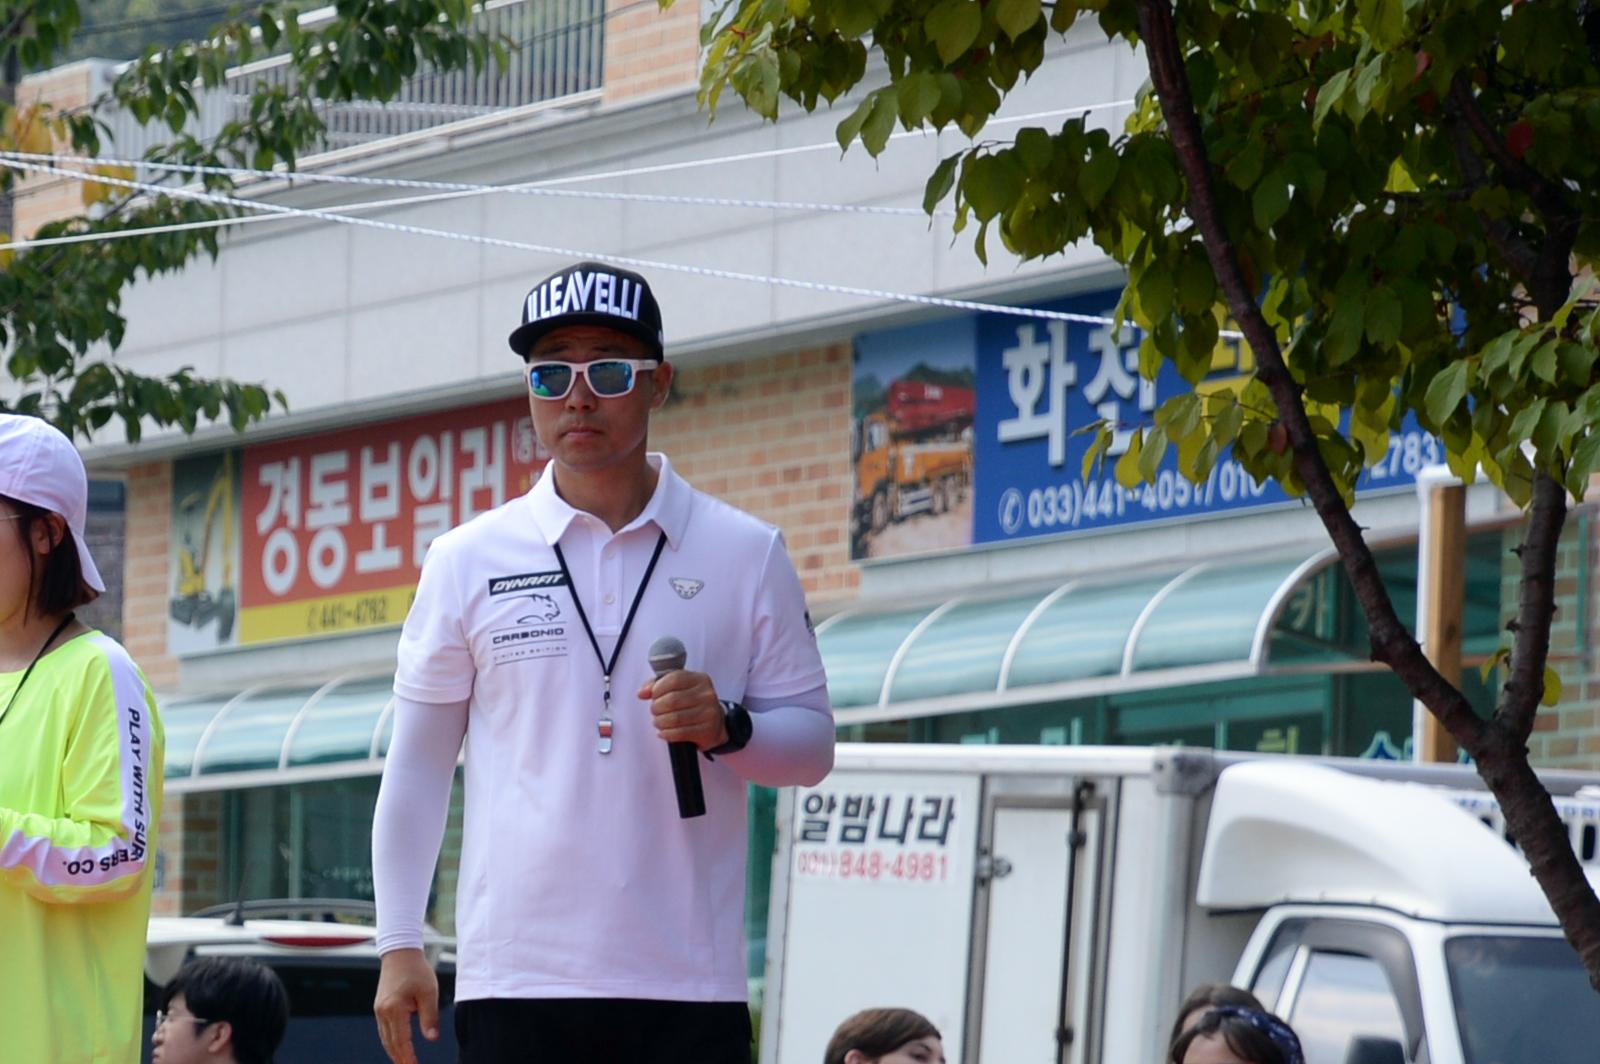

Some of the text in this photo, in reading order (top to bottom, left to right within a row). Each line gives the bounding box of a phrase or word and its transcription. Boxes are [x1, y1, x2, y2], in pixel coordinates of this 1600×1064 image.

[256, 420, 507, 596] 경동보일러
[491, 573, 564, 593] DYNAFIT
[127, 706, 142, 763] PLAY
[132, 763, 145, 818] WITH
[802, 793, 955, 846] 알밤나라
[62, 859, 95, 876] CO.
